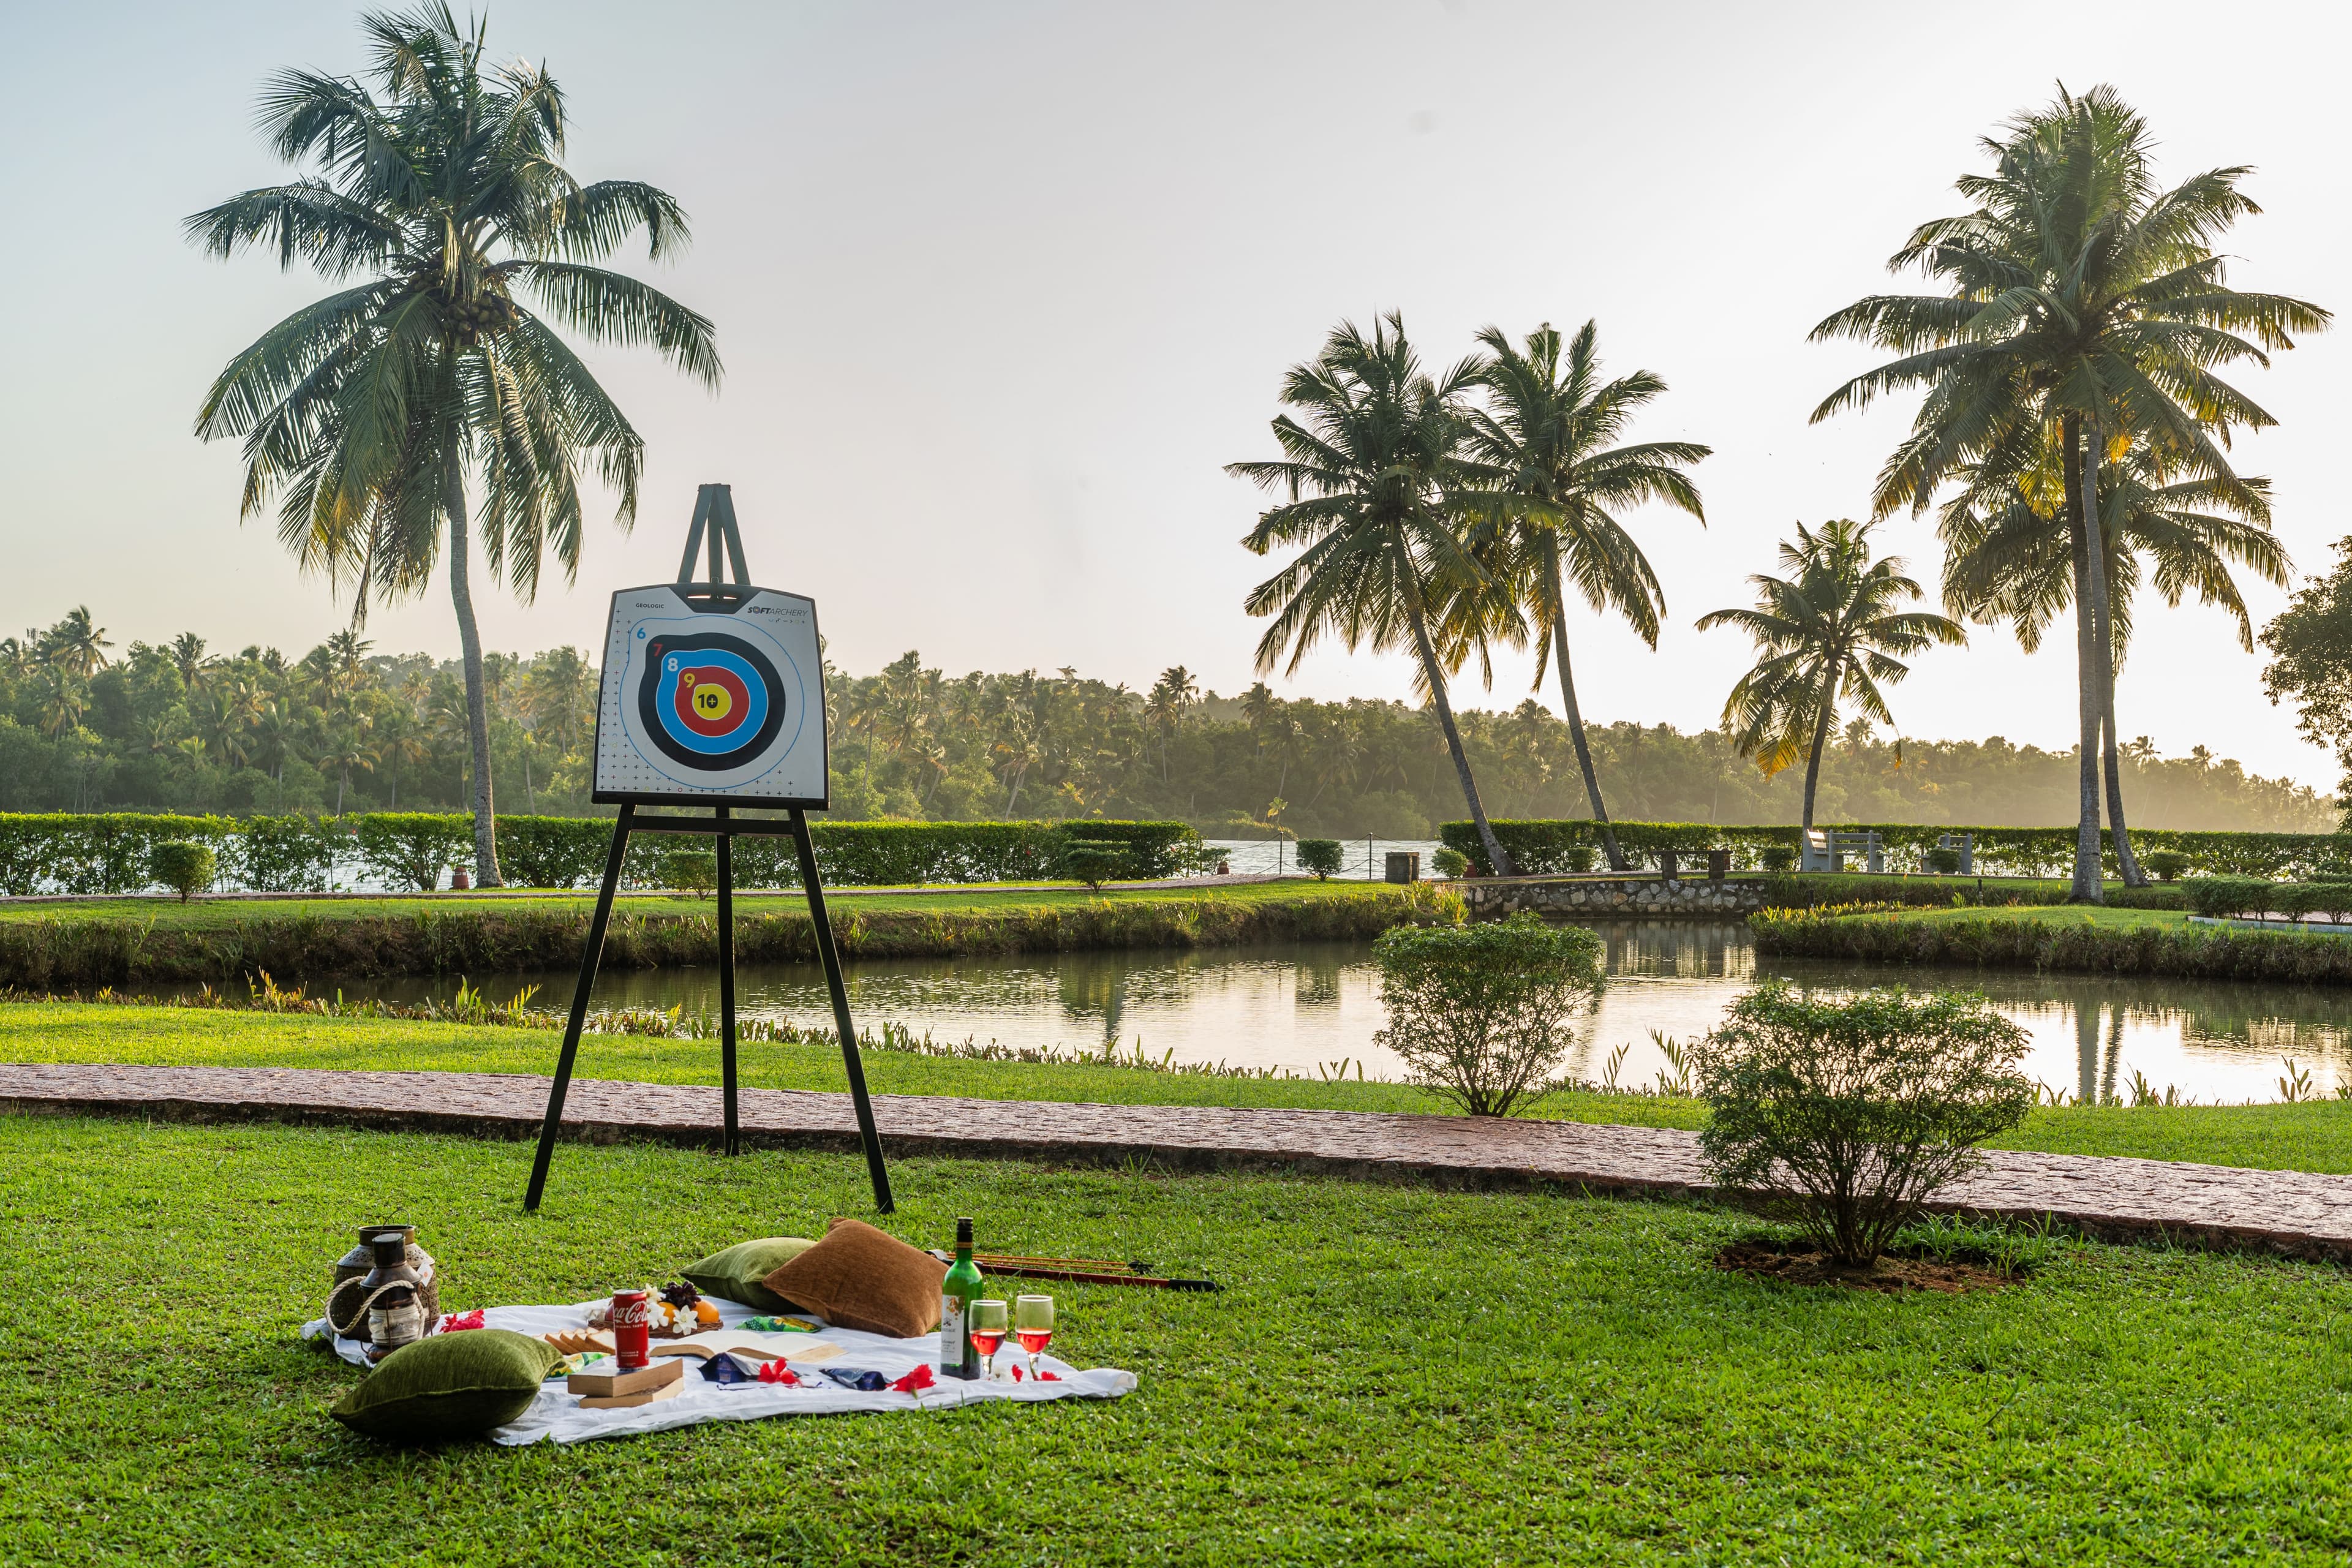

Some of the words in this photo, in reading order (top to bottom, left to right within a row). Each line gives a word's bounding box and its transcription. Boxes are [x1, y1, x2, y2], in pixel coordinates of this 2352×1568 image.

[747, 606, 808, 617] SOFTARCHERY
[636, 627, 646, 639] 6
[653, 643, 663, 657] 7
[667, 657, 679, 672] 8
[684, 673, 695, 688] 9
[698, 693, 718, 709] 10
[614, 1300, 647, 1324] ca-Col
